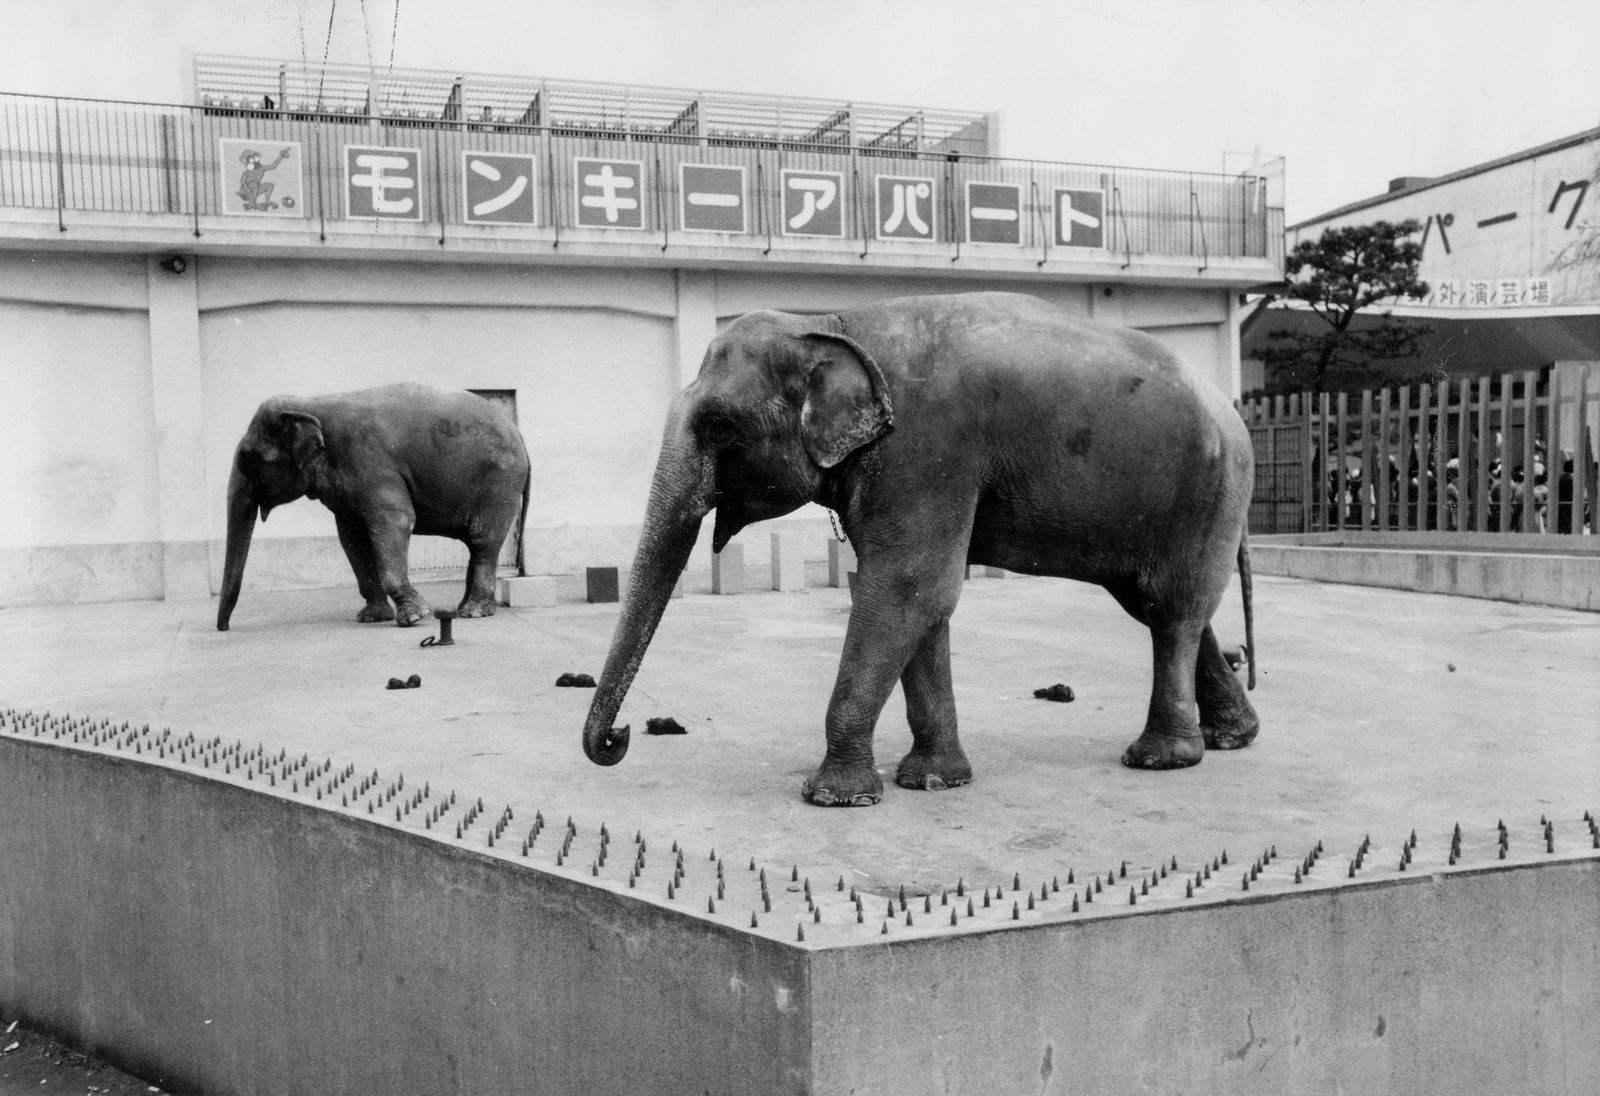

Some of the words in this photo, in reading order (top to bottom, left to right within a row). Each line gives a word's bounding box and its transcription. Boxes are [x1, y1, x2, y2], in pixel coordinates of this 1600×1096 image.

[351, 154, 1101, 244] モンキーアパート
[1420, 180, 1591, 256] パーク
[1408, 280, 1549, 306] 外演芸場
